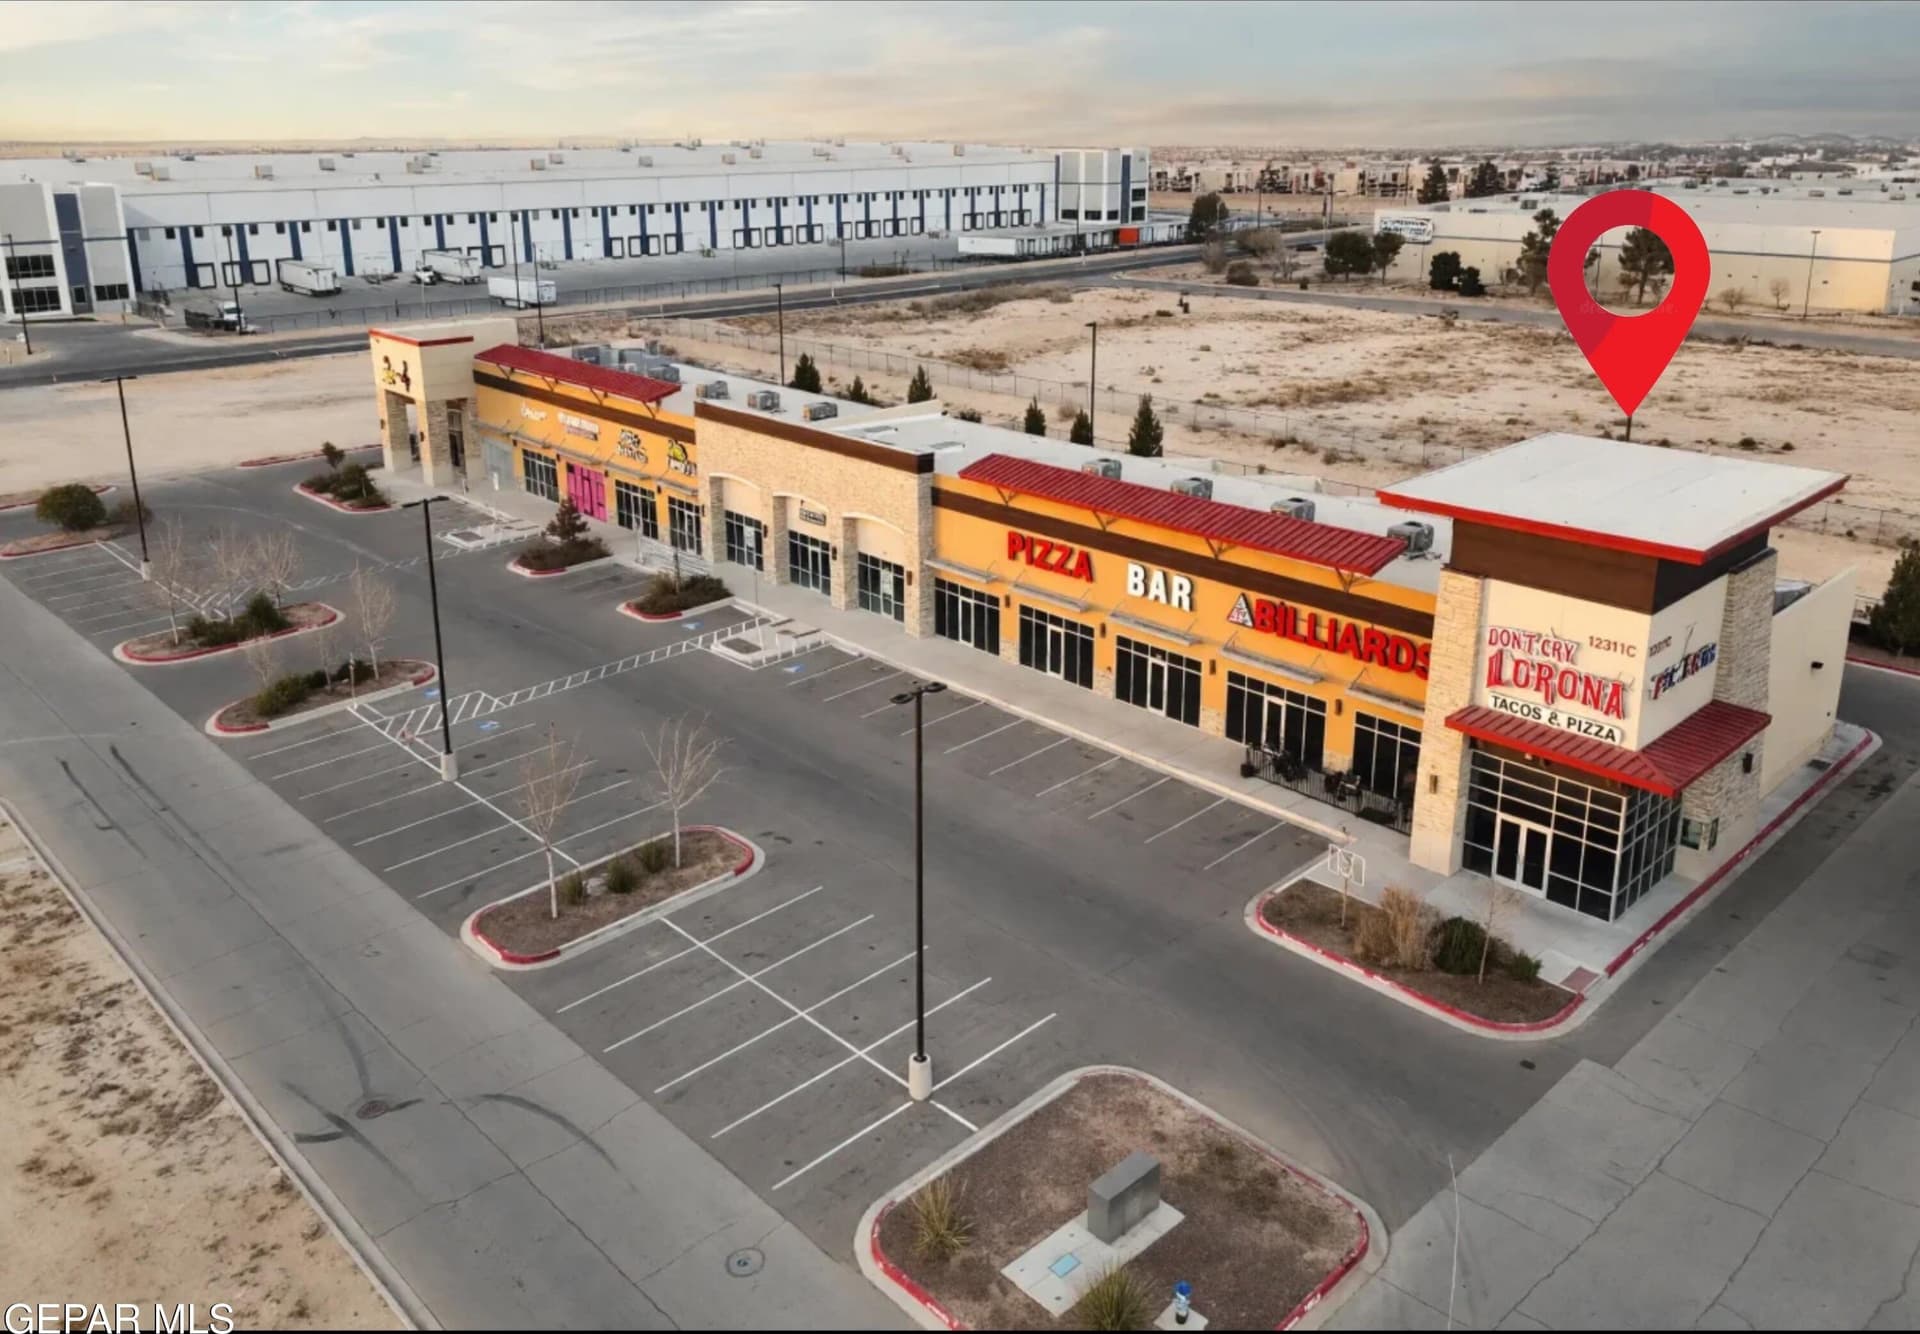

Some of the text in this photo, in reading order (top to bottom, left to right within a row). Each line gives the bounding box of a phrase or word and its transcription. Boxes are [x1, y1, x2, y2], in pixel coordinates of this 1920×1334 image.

[1007, 530, 1094, 582] PIZZA
[1126, 563, 1193, 612] BAR
[1541, 639, 1576, 662] CRY
[1588, 635, 1638, 658] 12311C
[1491, 695, 1542, 721] TACOS
[1567, 716, 1618, 742] PIZZA
